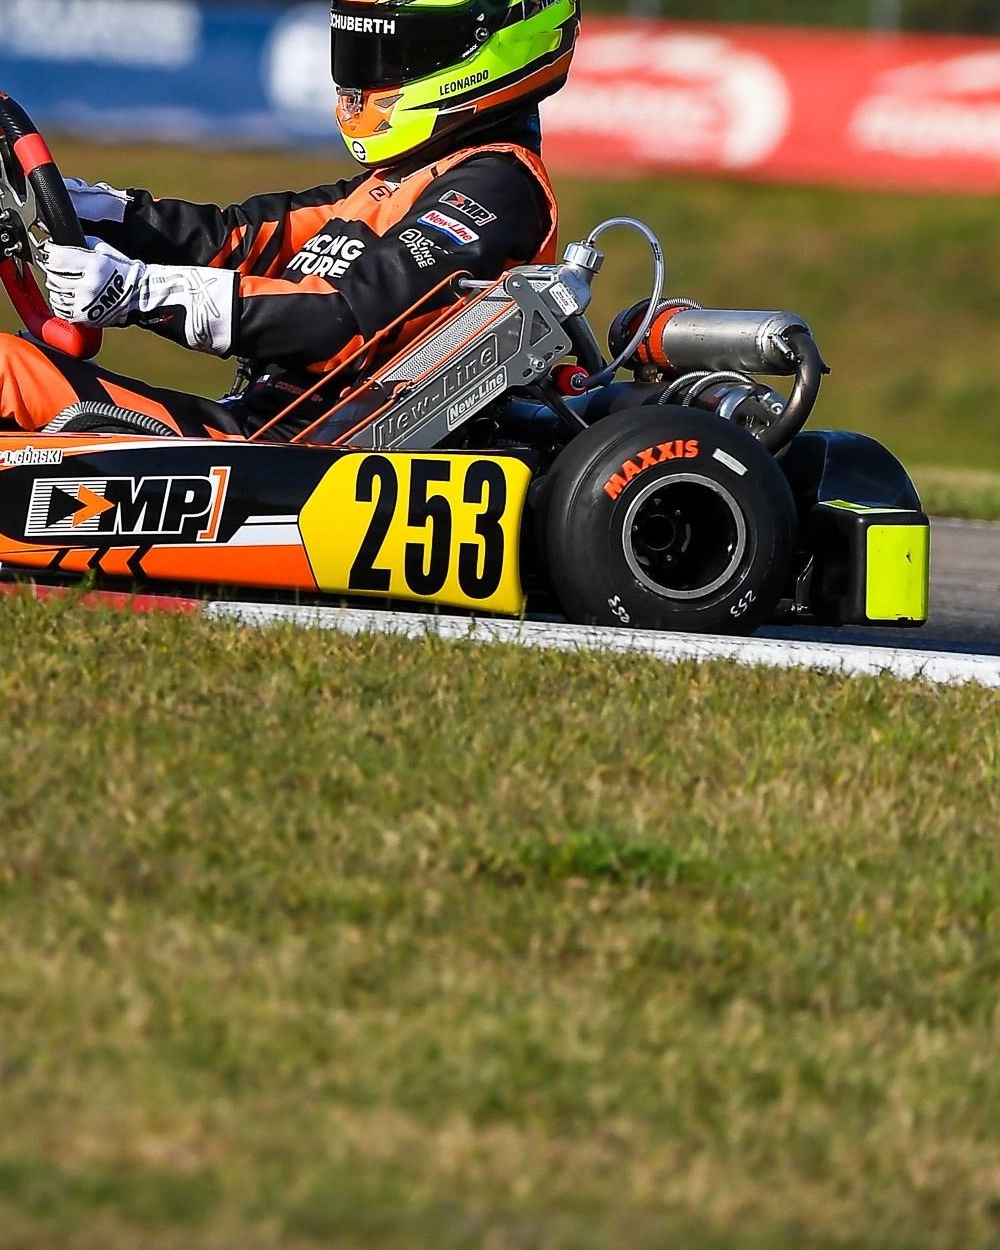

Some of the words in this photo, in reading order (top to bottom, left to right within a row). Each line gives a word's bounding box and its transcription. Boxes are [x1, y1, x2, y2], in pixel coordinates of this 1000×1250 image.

[439, 69, 489, 96] LEONARDO
[425, 212, 473, 242] New-Line
[87, 274, 125, 321] OMP
[449, 373, 504, 421] New-Line
[604, 439, 699, 500] MAXXIS
[348, 455, 506, 600] 253
[726, 589, 756, 618] 253
